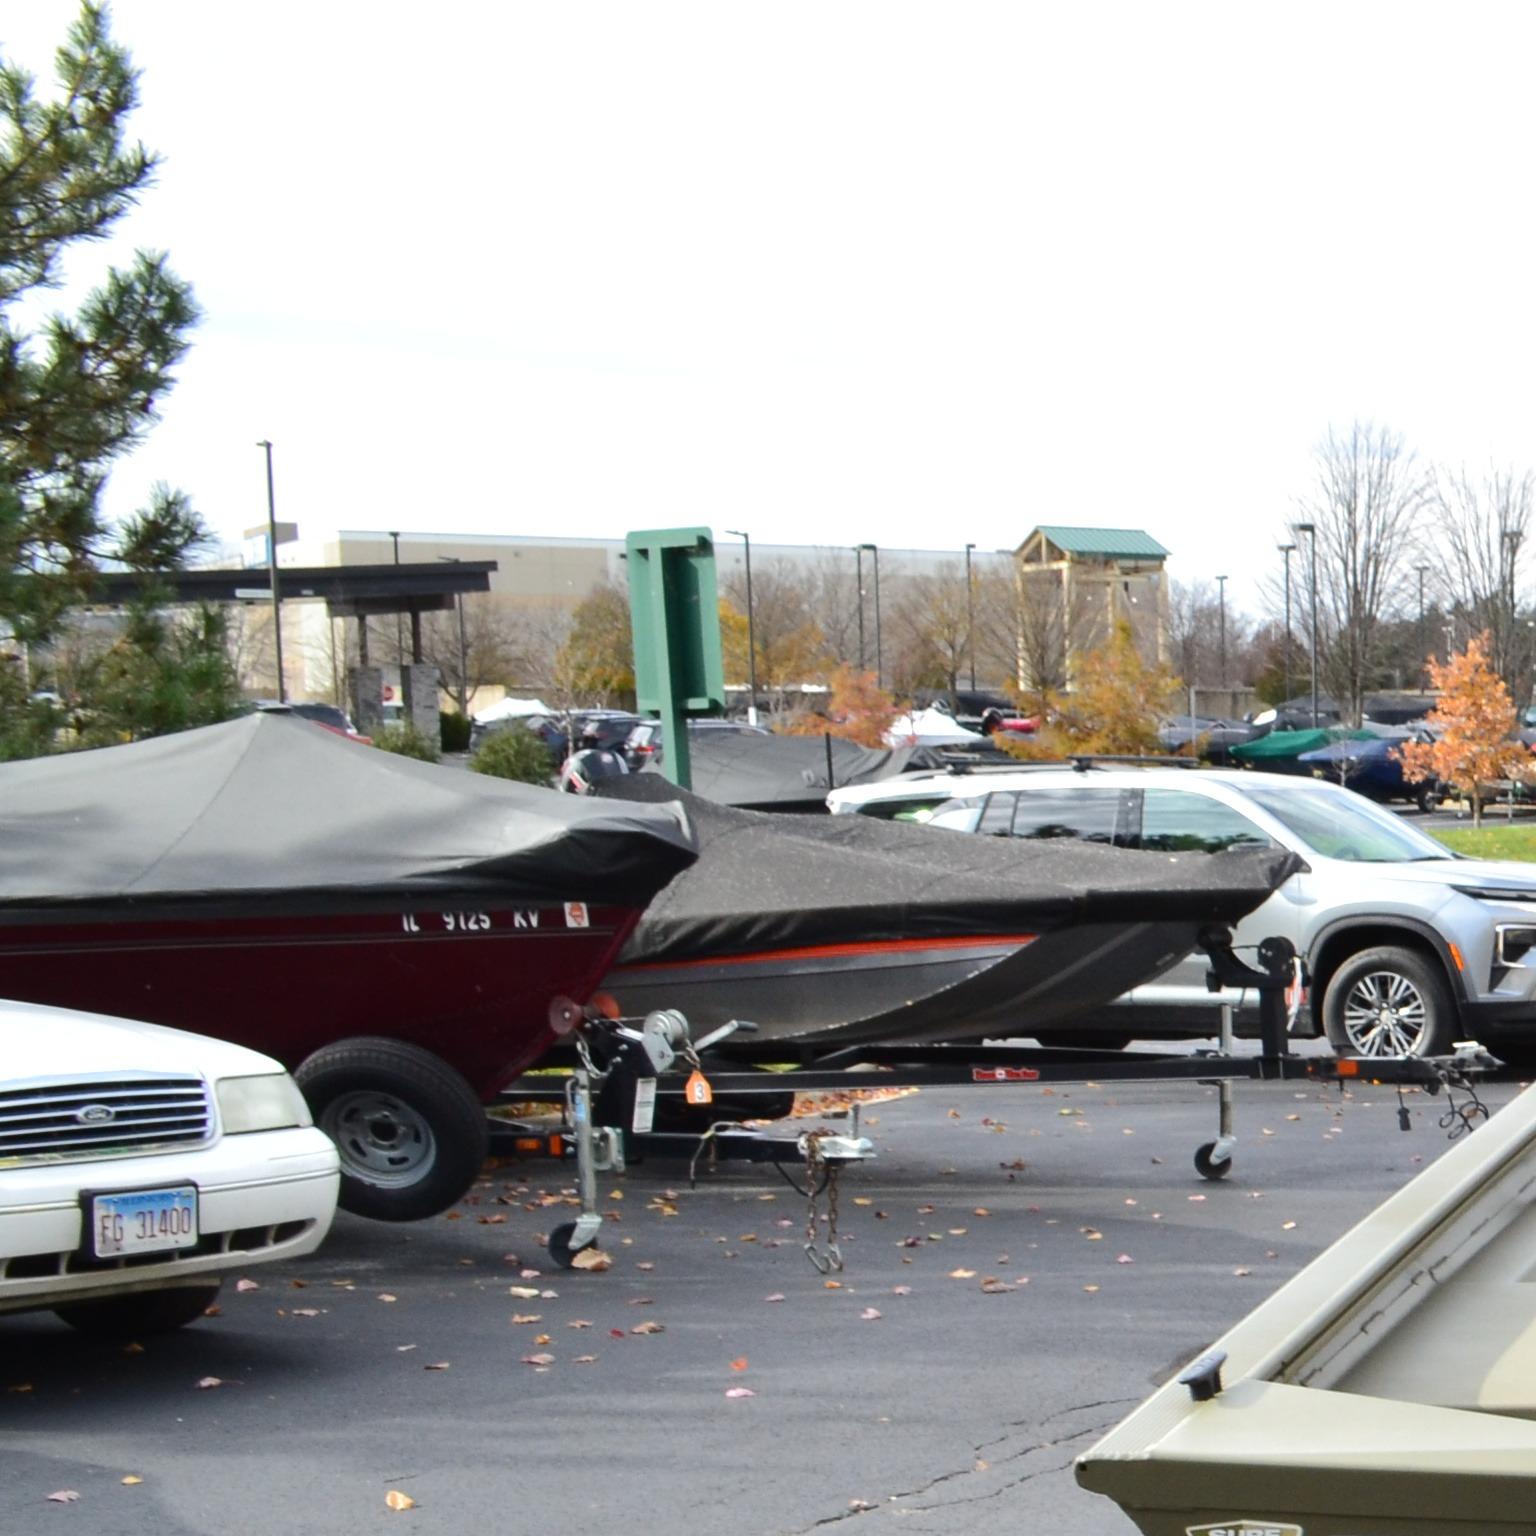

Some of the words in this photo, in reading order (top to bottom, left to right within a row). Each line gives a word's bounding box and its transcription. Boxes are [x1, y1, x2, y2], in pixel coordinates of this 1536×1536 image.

[696, 1083, 704, 1100] 3
[101, 1213, 124, 1245] FG
[135, 1206, 192, 1240] 31400
